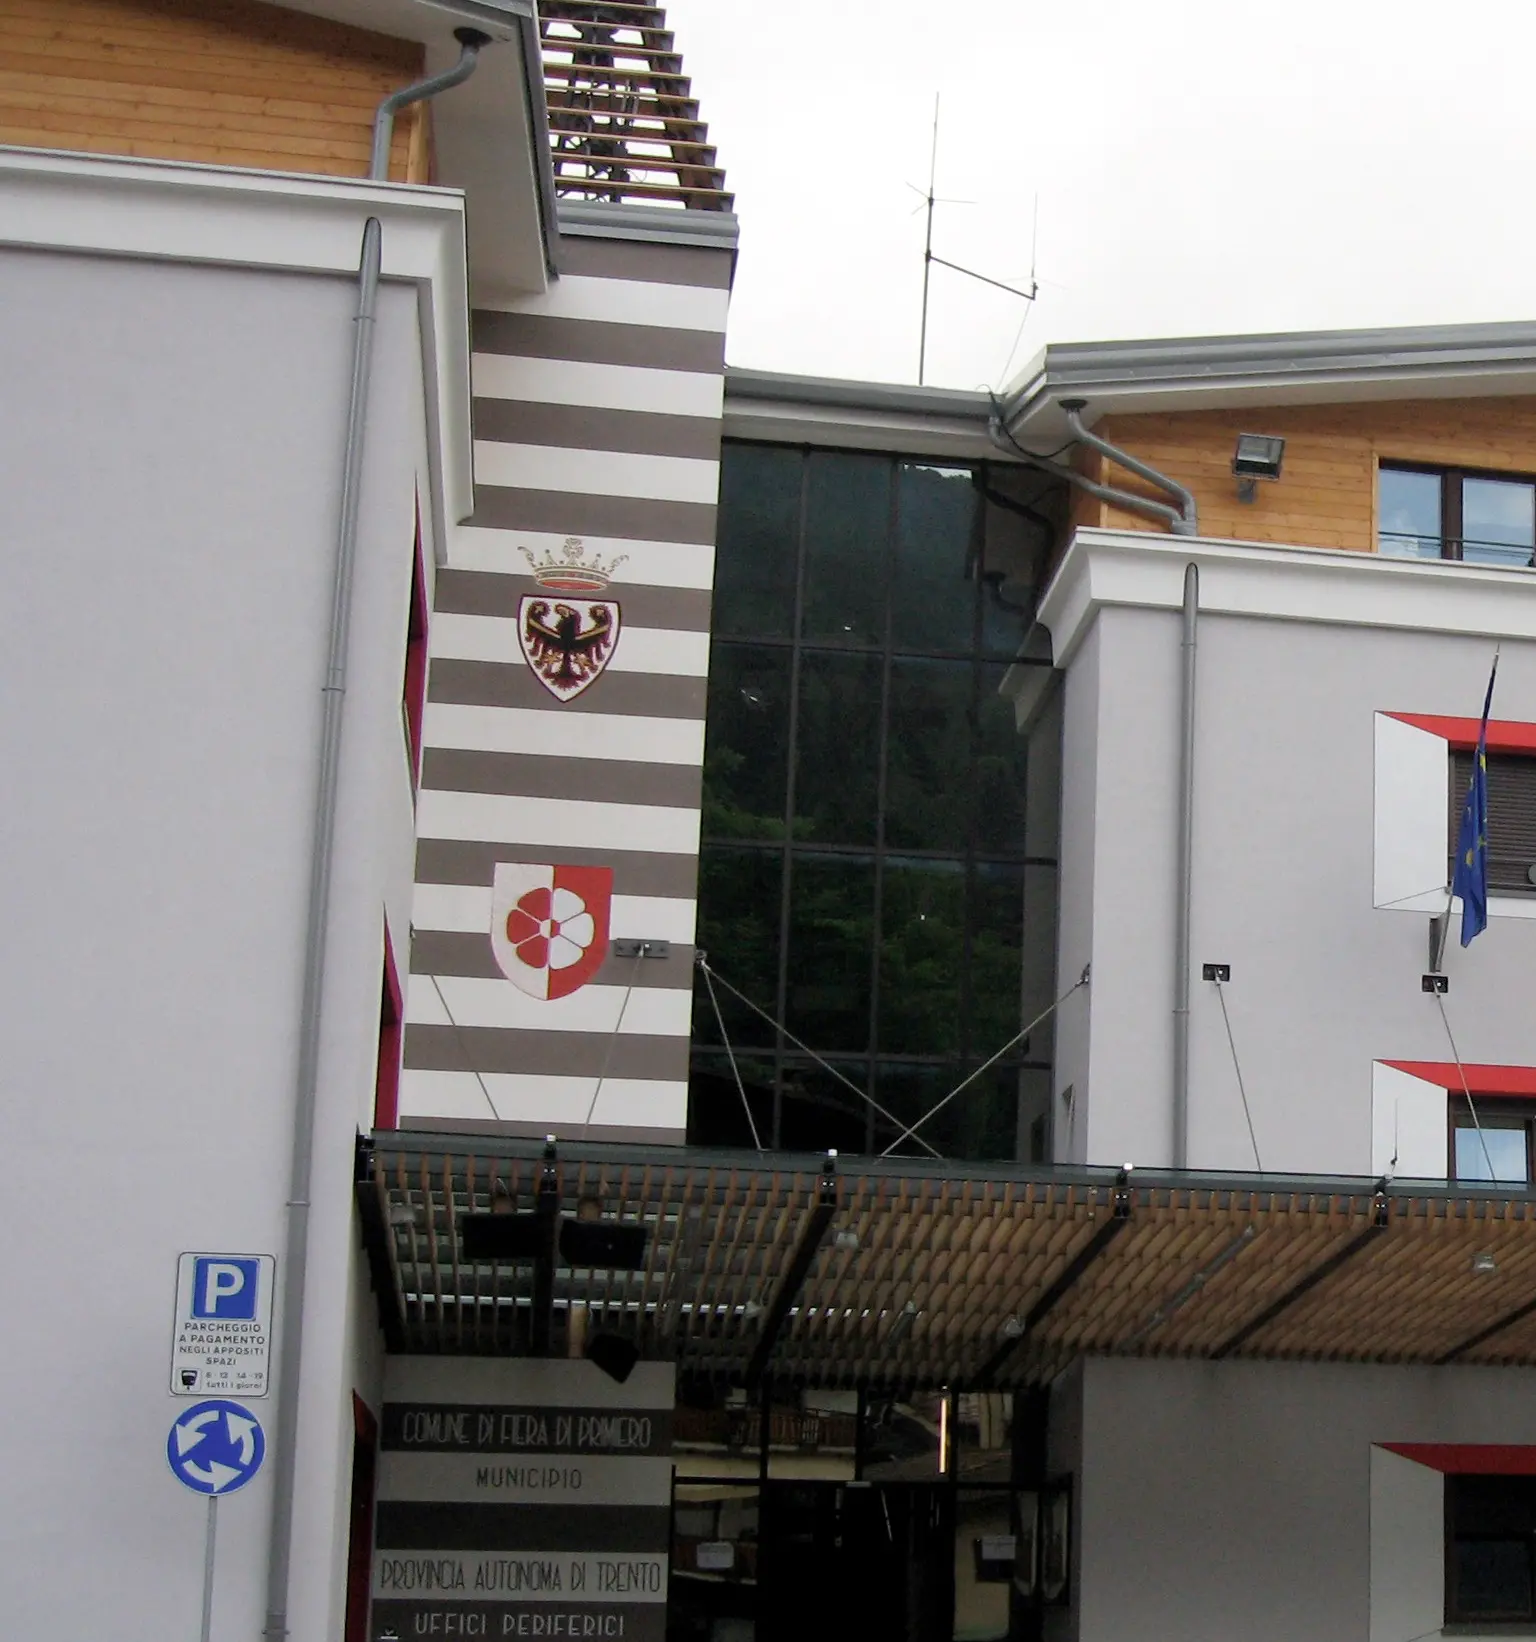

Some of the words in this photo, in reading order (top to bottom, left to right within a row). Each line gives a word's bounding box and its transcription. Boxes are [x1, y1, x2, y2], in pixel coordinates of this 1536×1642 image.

[205, 1263, 245, 1314] P
[184, 1322, 261, 1333] PARCHEGGIO
[179, 1334, 187, 1343] A
[190, 1334, 266, 1345] PAGAMENTO
[179, 1346, 211, 1354] NEGLI
[213, 1346, 264, 1356] APPOSITI
[205, 1356, 237, 1366] SPAZI
[206, 1381, 228, 1389] tutti
[402, 1411, 471, 1444] COMUNE
[477, 1412, 494, 1445] DI
[500, 1413, 548, 1446] FIERA
[555, 1415, 572, 1447] DI
[577, 1416, 652, 1448] PRIMIERO
[475, 1466, 583, 1490] MUNICIPIO
[380, 1559, 465, 1591] PROVINCIA
[475, 1560, 562, 1592] AUTONOMA
[570, 1561, 586, 1593] DI
[596, 1562, 661, 1593] TRENTO
[415, 1613, 486, 1635] UFFICI
[503, 1614, 624, 1637] PERIFERICI
